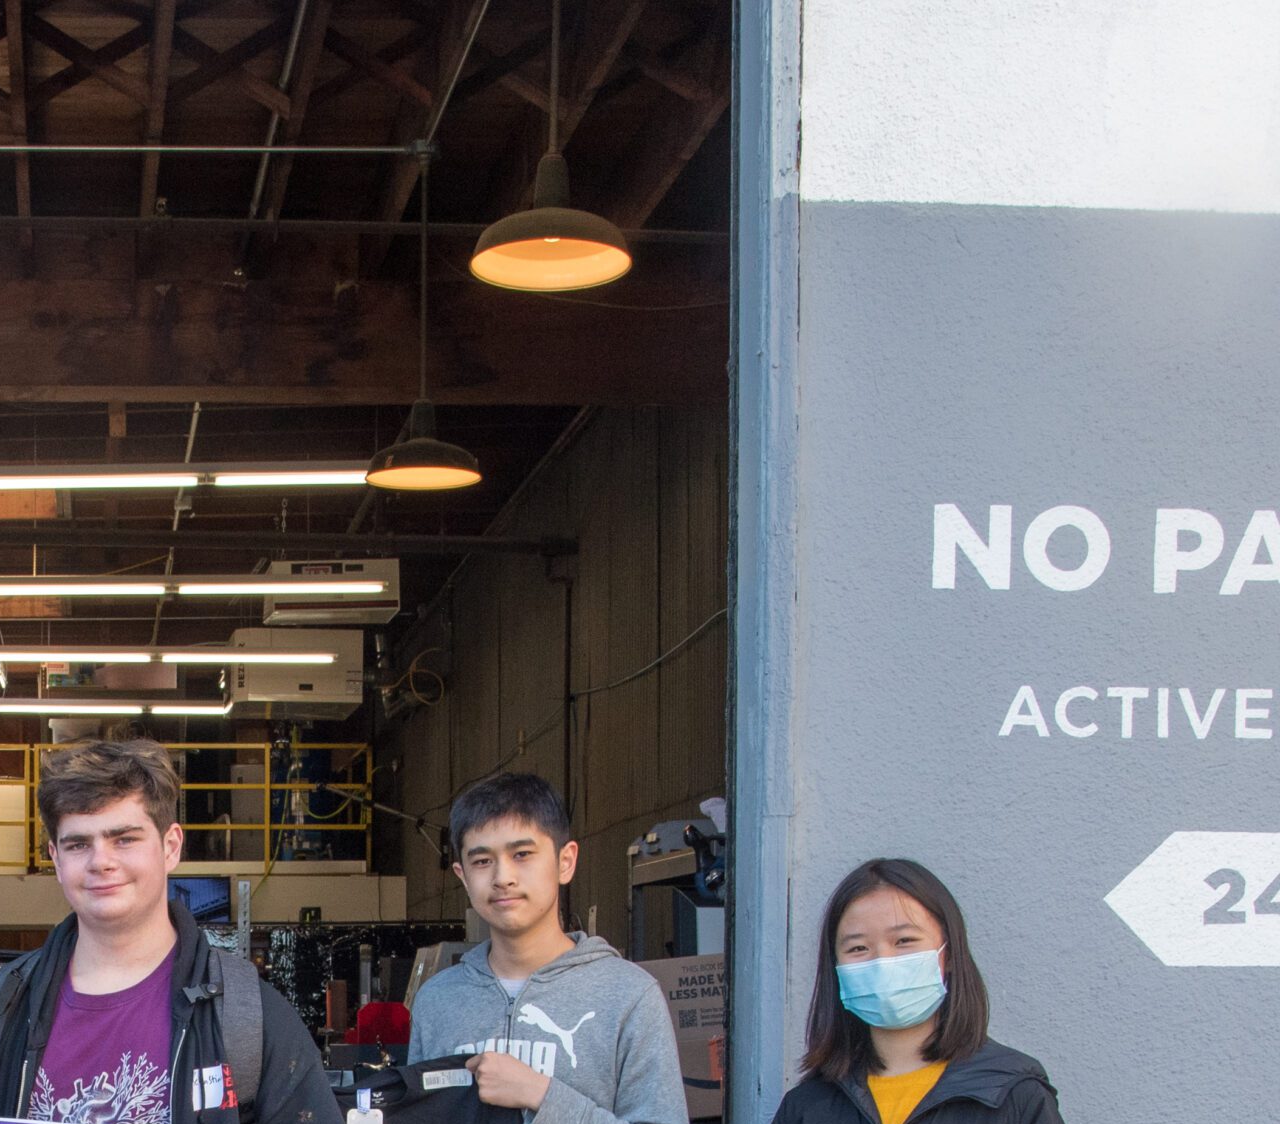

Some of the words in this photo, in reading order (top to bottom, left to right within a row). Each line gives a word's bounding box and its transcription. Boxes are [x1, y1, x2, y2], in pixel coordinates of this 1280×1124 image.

[932, 503, 1111, 592] NO
[998, 685, 1273, 740] ACTIVE
[669, 988, 698, 1001] LESS
[678, 974, 715, 987] MADE
